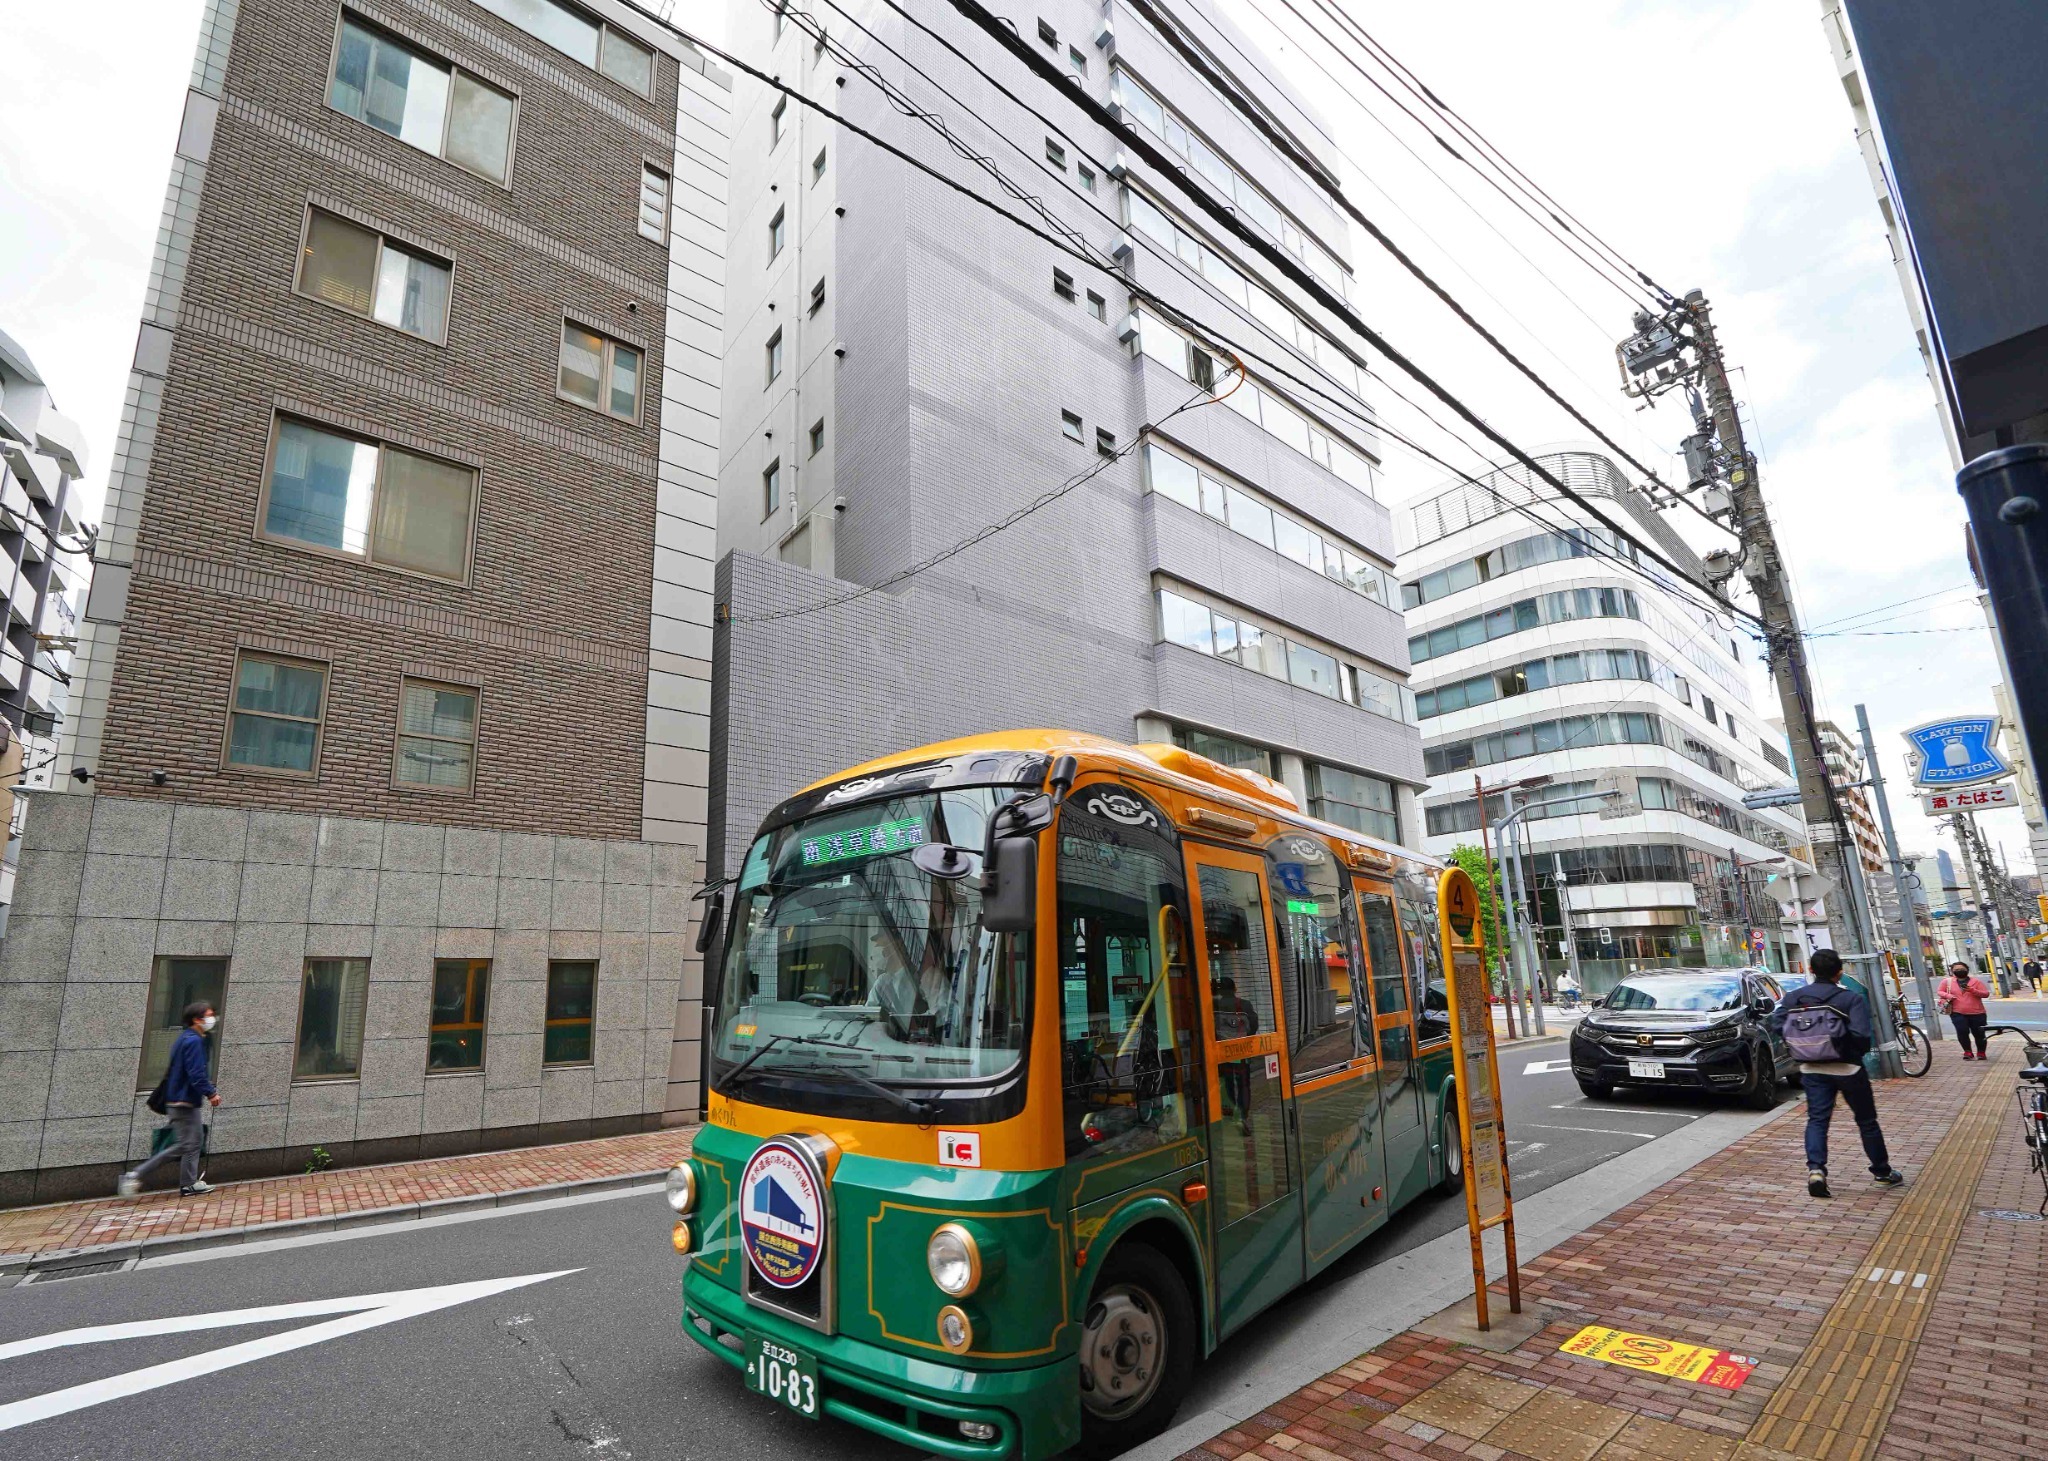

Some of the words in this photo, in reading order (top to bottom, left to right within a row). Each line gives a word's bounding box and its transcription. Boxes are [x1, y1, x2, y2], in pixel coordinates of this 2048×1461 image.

[1918, 724, 1984, 743] LAWSON
[1927, 760, 1995, 778] STATION
[1931, 789, 2006, 809] 酒・たばこ
[1453, 885, 1464, 912] 4
[747, 1362, 756, 1375] あ
[759, 1354, 815, 1414] 10-83
